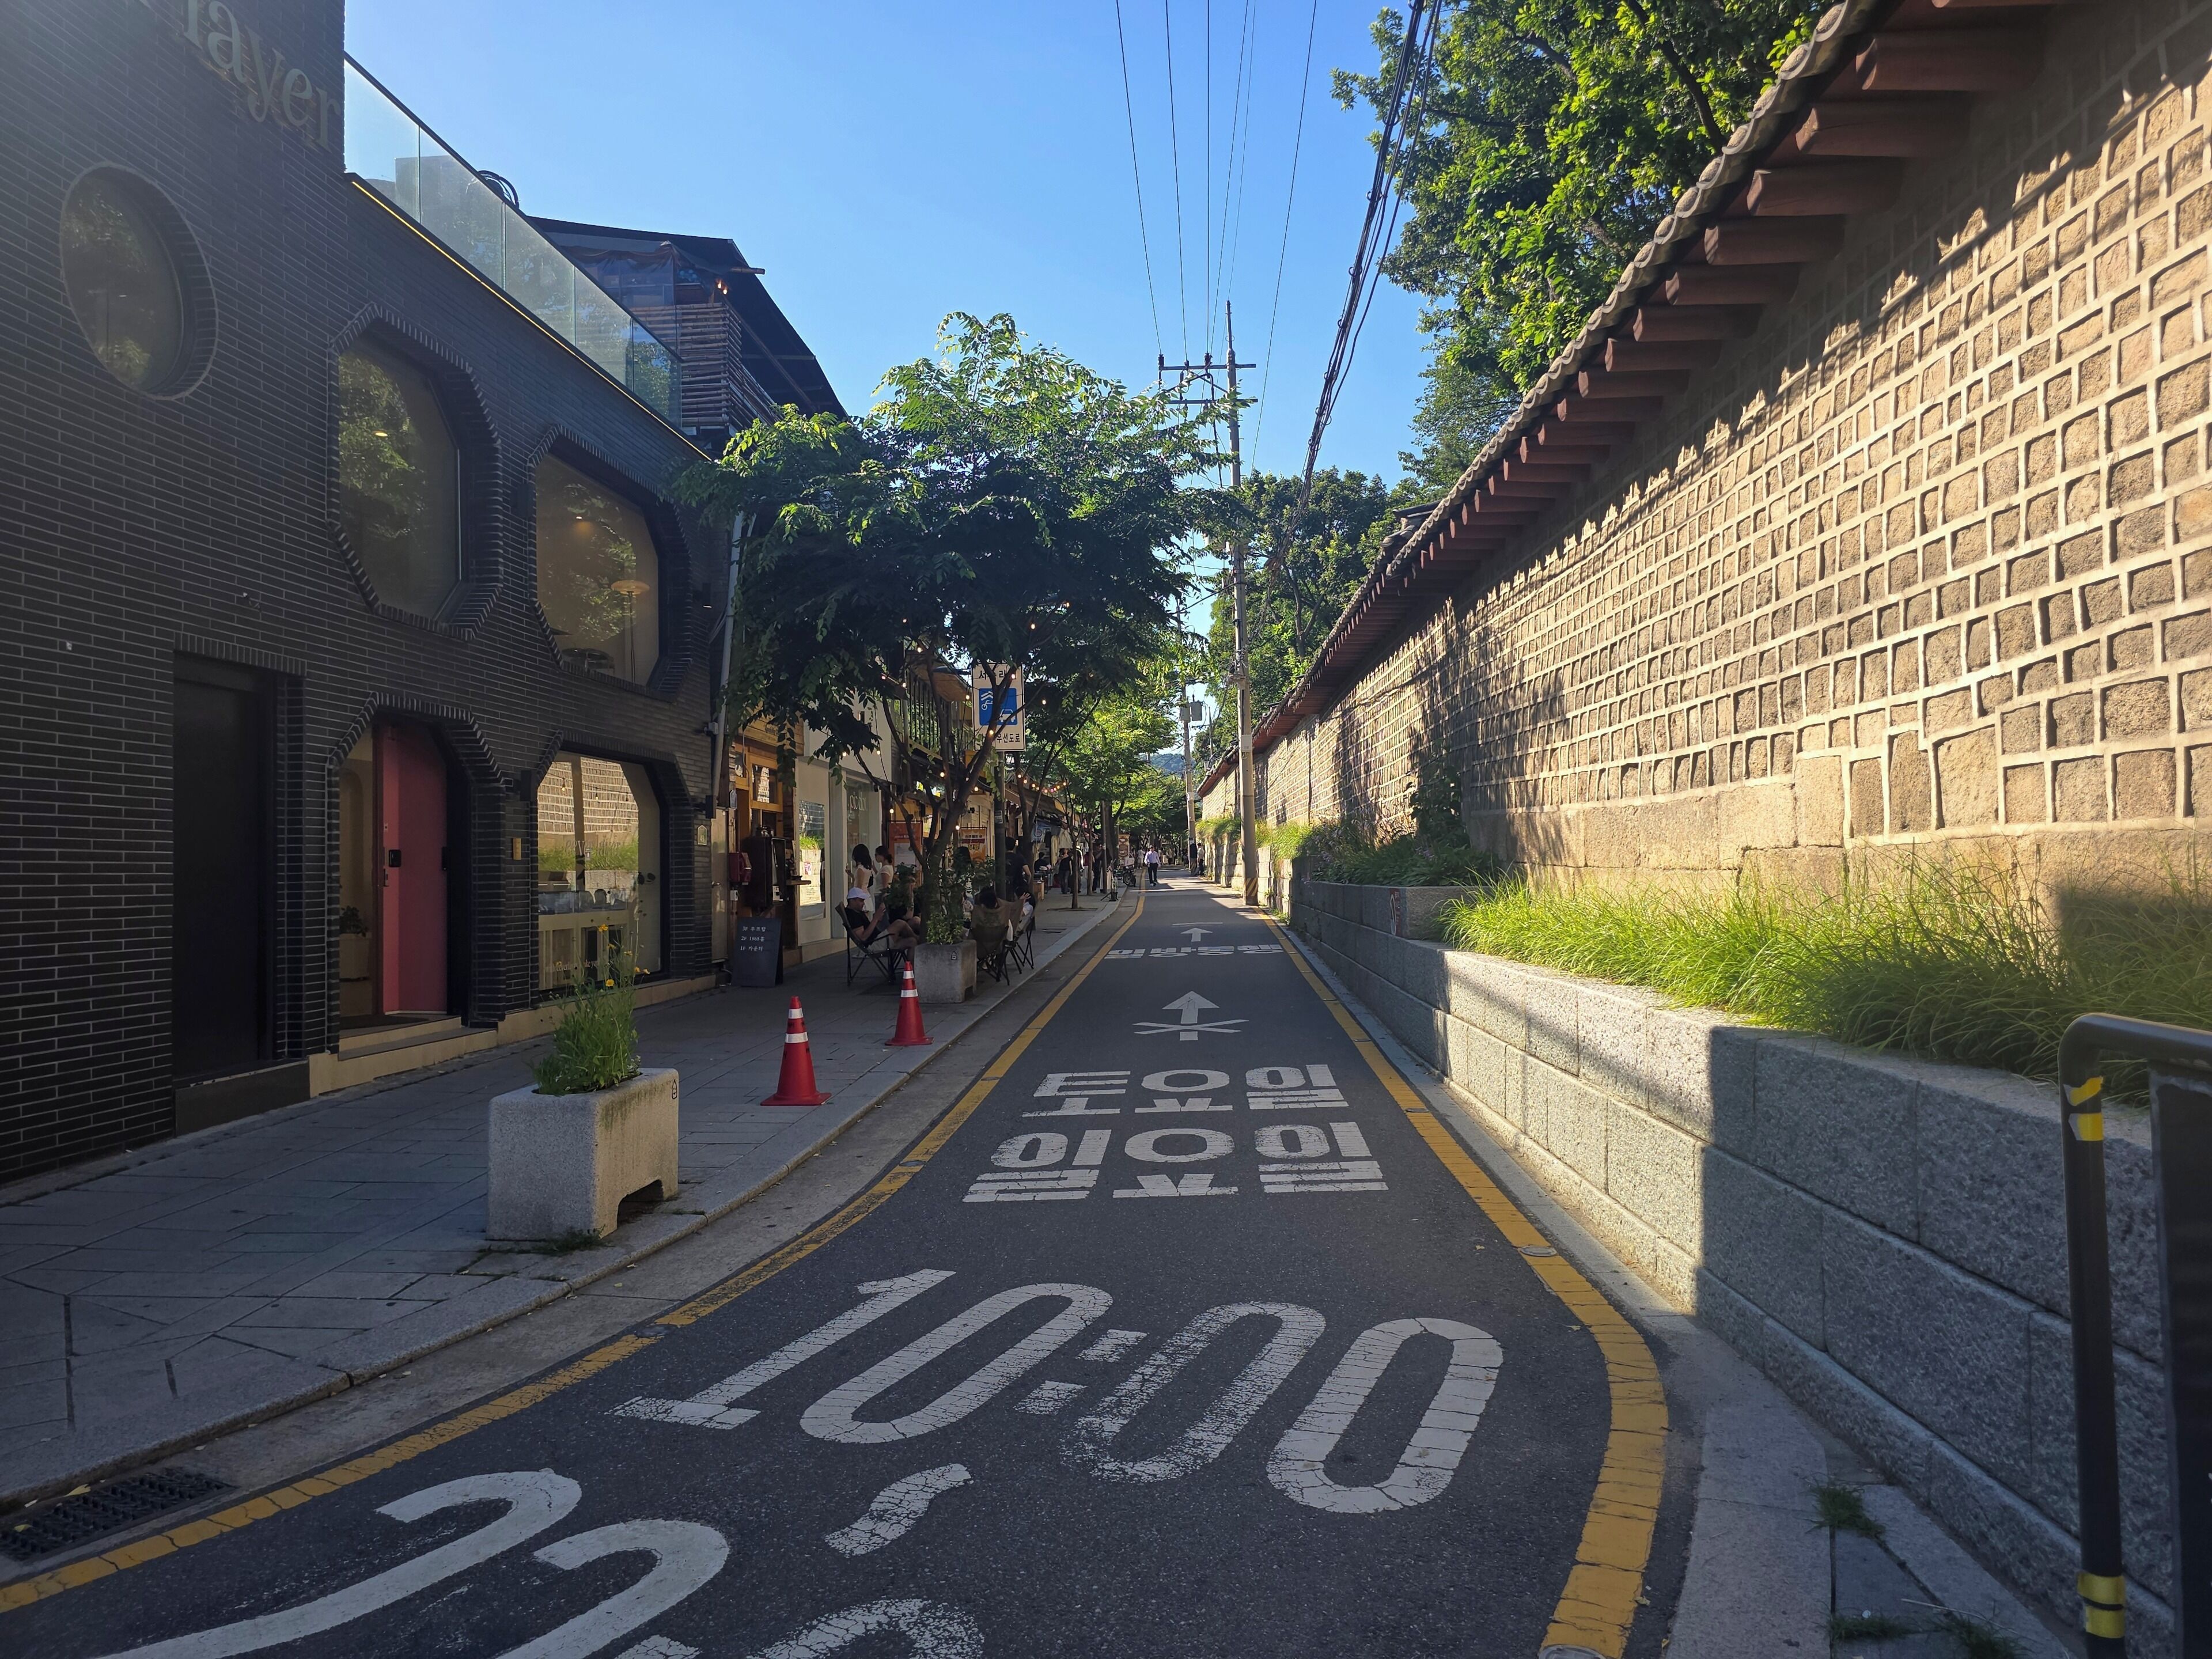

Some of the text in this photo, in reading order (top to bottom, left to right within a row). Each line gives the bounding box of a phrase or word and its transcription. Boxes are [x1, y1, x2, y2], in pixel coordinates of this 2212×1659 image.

[1104, 944, 1285, 960] 일방통행
[1021, 1064, 1350, 1118] 토요일
[962, 1122, 1389, 1203] 일요일
[612, 1268, 1505, 1516] 10:00
